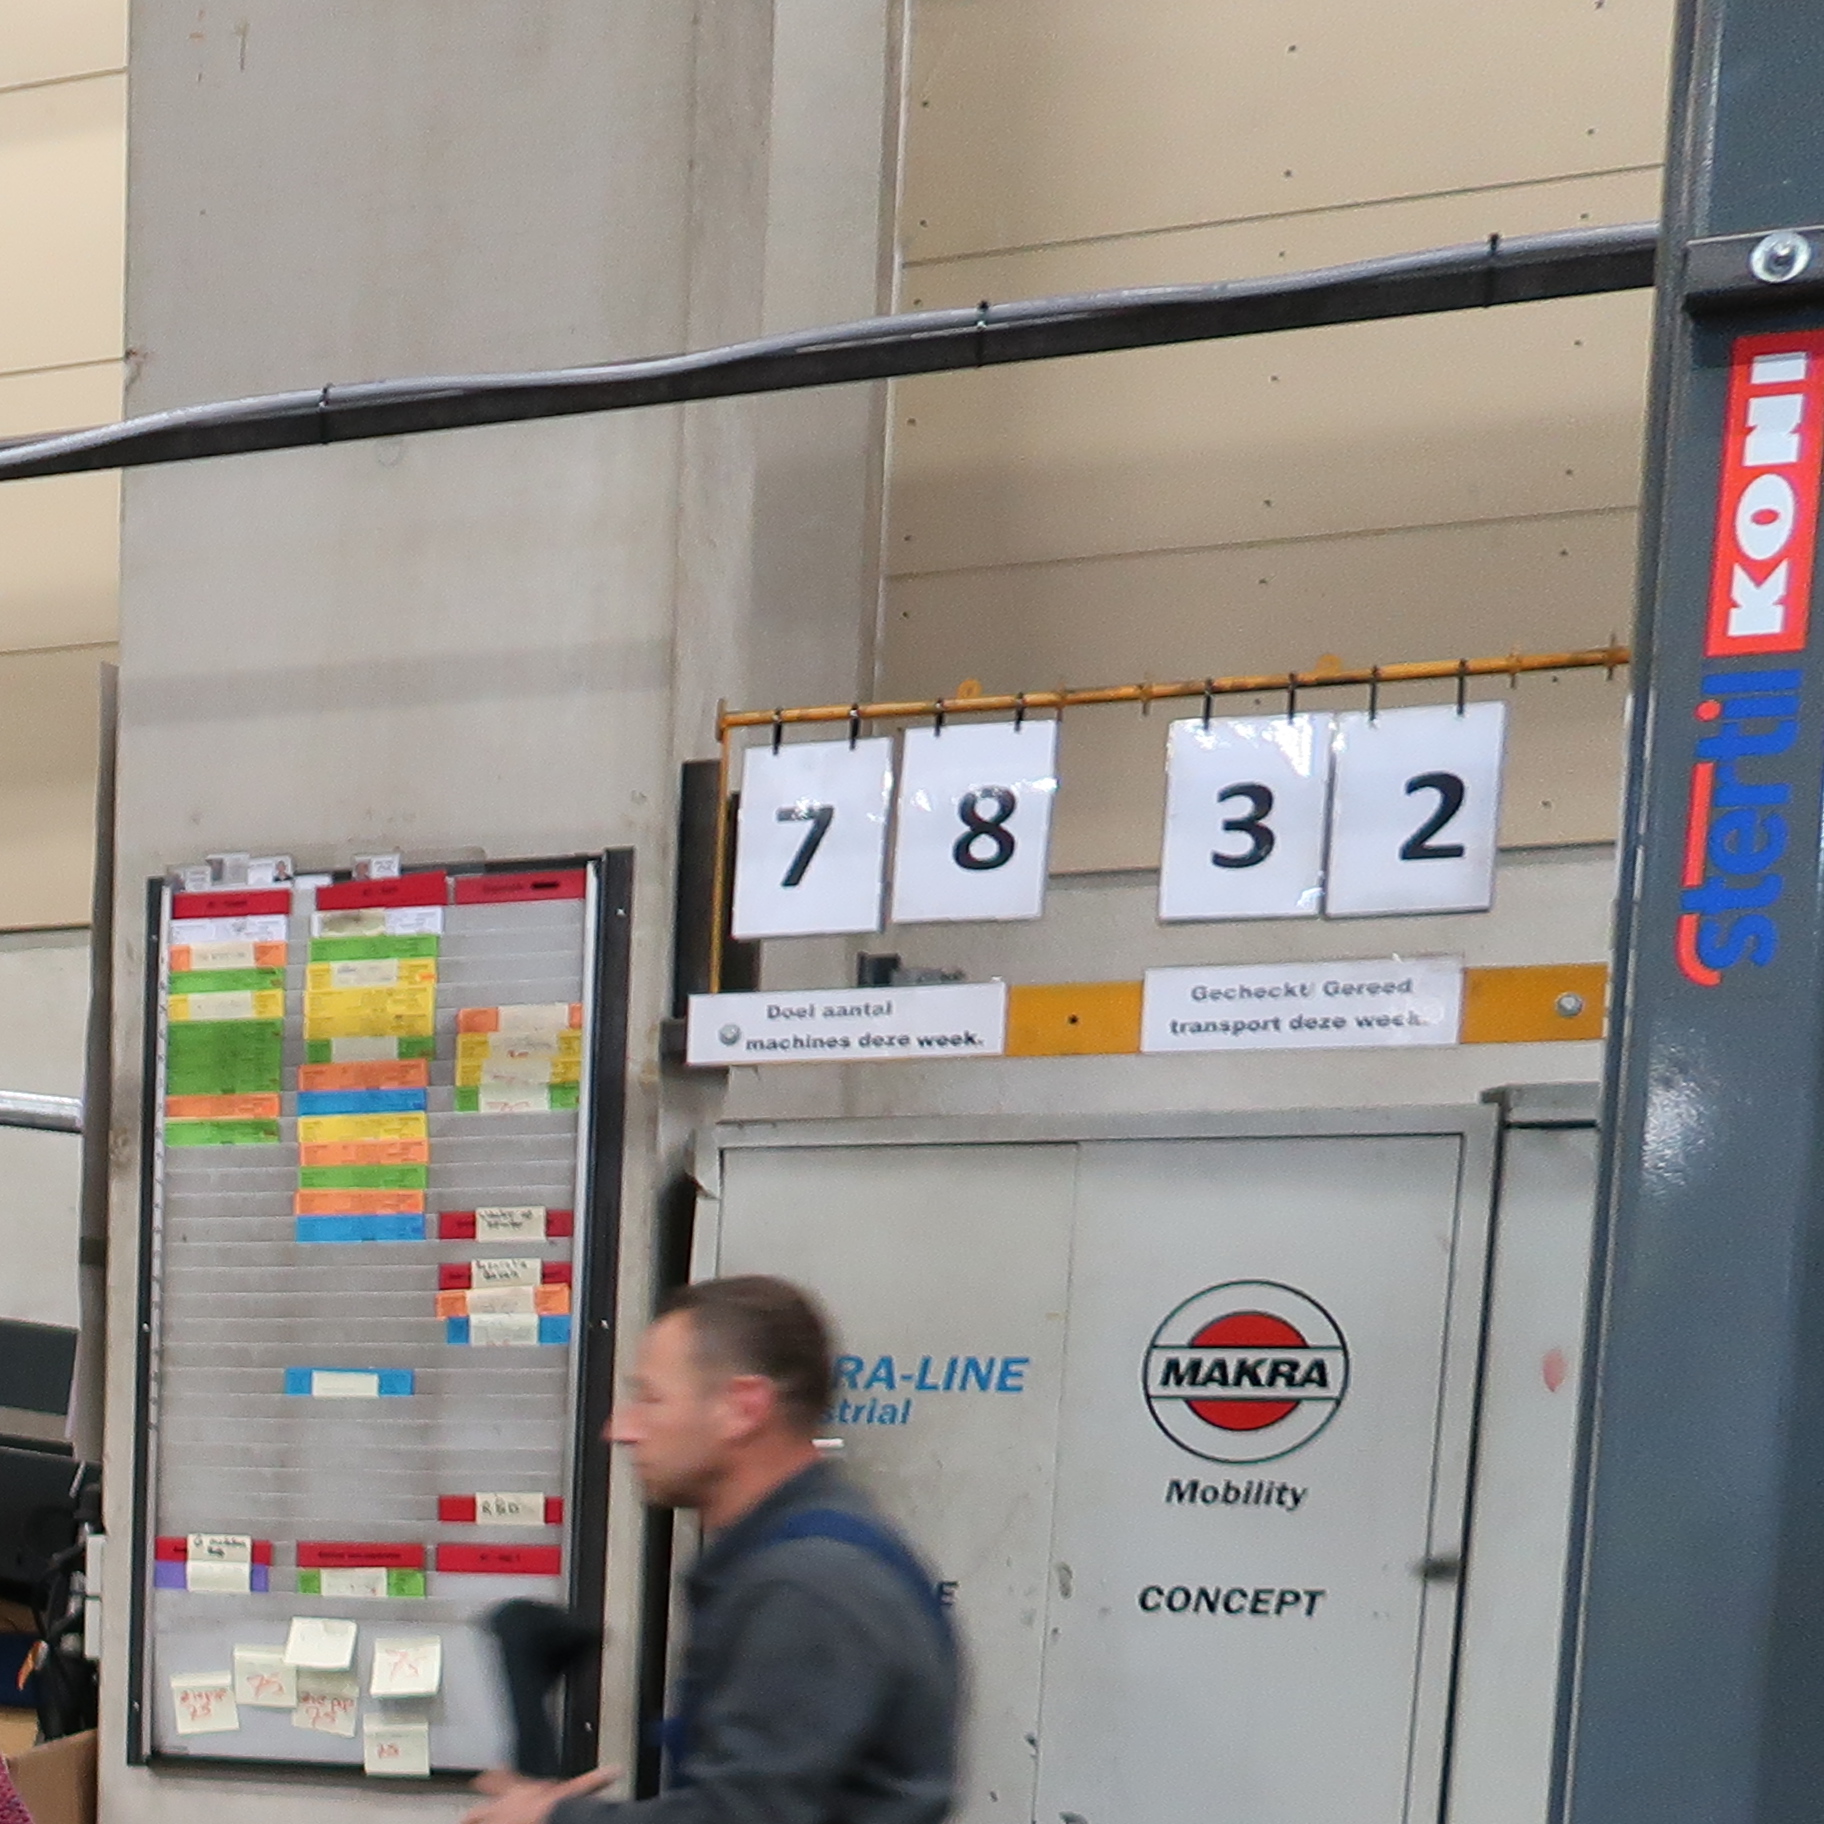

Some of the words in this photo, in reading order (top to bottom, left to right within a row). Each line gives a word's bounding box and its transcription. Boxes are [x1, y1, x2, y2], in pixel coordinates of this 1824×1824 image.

[1727, 352, 1808, 636] KONI
[1210, 782, 1275, 868] 3
[1399, 771, 1467, 860] 2
[1676, 668, 1803, 987] stertil
[776, 804, 834, 887] 7
[951, 786, 1016, 870] 8
[1322, 978, 1414, 998] Gereed
[767, 1003, 815, 1019] Doel
[823, 1001, 893, 1018] aantal
[1170, 1015, 1281, 1037] transport
[1289, 1012, 1346, 1030] deze
[745, 1033, 851, 1051] machines
[858, 1031, 911, 1048] deze
[830, 1355, 1030, 1393] RA-LINE
[1161, 1358, 1329, 1388] MAKRA
[1166, 1480, 1309, 1513] Mobility
[1139, 1586, 1326, 1617] CONCEPT
